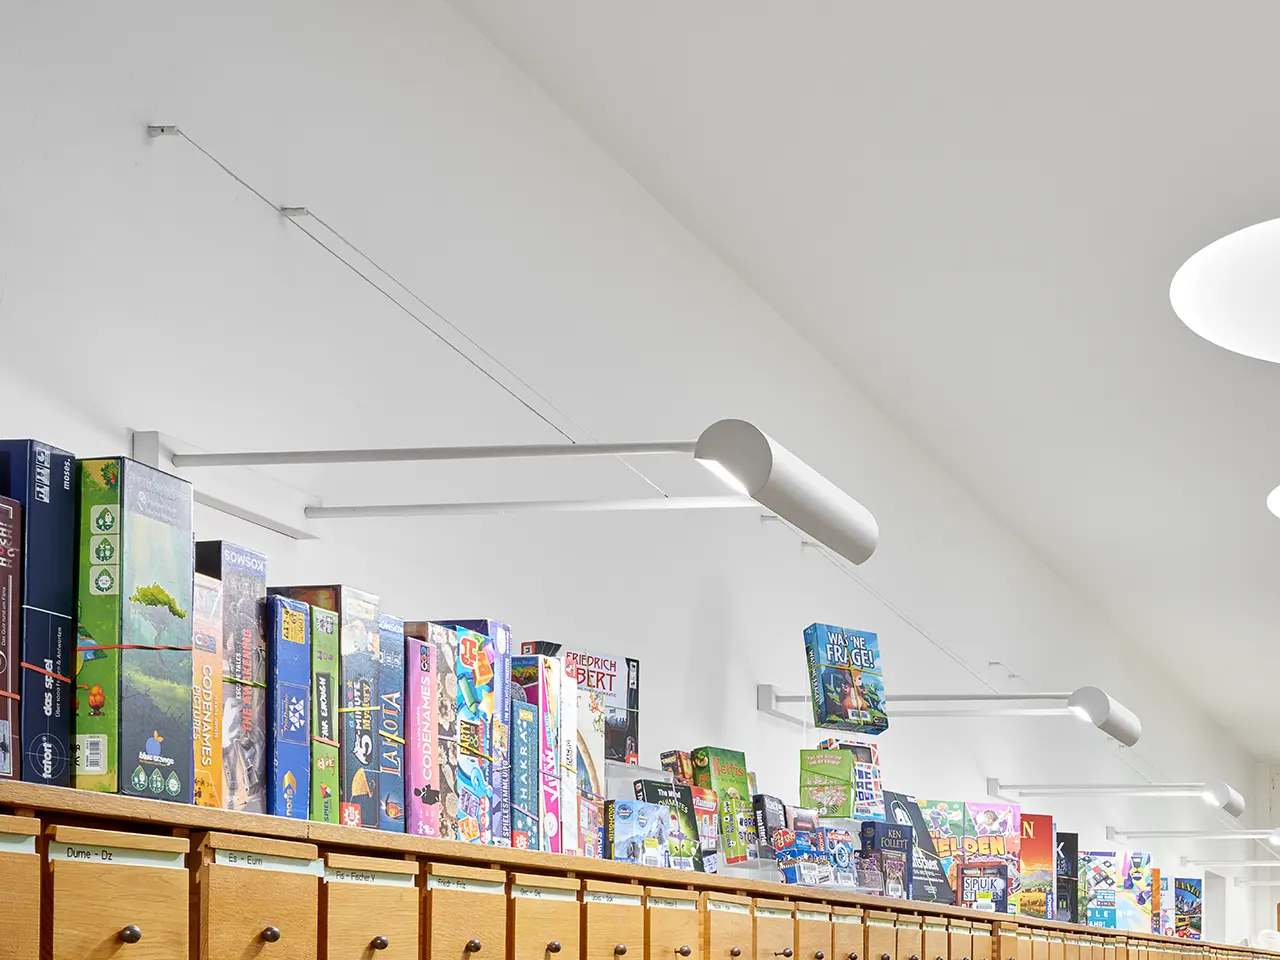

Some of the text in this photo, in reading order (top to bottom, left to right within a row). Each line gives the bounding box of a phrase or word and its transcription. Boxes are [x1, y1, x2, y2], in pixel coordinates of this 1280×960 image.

[63, 458, 71, 490] moses.
[224, 550, 264, 571] KOSMOS
[827, 632, 848, 646] WAS
[566, 651, 617, 673] FRIEDRICH
[826, 643, 875, 668] FRAGE!
[576, 668, 617, 692] BERT
[318, 677, 328, 717] ENOUGH
[193, 685, 201, 740] PICTURES
[202, 664, 213, 766] CODENAMES
[242, 708, 252, 731] THE
[379, 691, 402, 777] LAKOTA
[421, 676, 433, 781] CODENAMES
[460, 721, 472, 755] PARTY
[712, 757, 744, 777] Keltis
[283, 788, 293, 816] noris
[657, 788, 682, 799] The Mind
[881, 838, 909, 850] FOLLETT
[887, 829, 902, 839] KEN
[66, 847, 113, 861] Dume Dz
[228, 854, 237, 863] Es
[963, 877, 998, 890] SPUK
